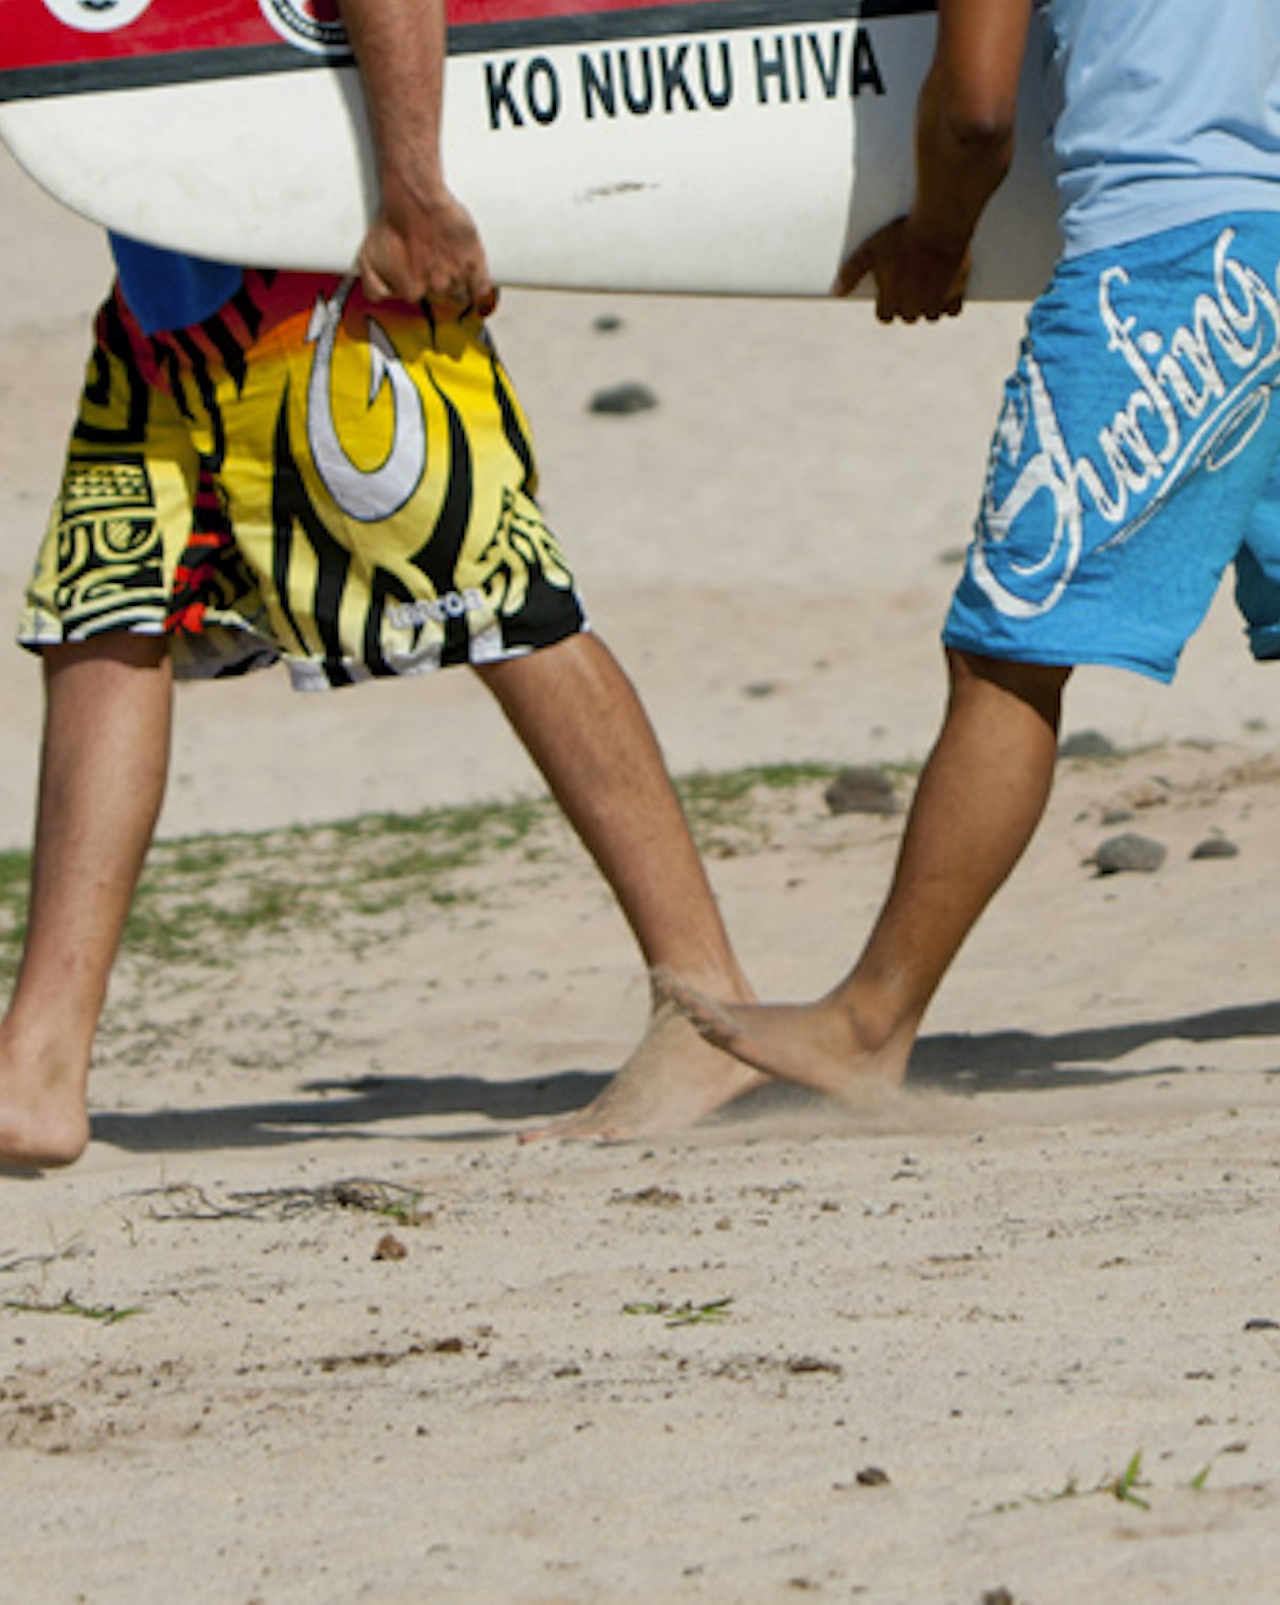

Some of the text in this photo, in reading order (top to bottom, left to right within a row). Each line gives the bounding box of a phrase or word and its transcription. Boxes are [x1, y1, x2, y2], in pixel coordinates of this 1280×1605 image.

[483, 26, 887, 130] KO NUKU HIVA
